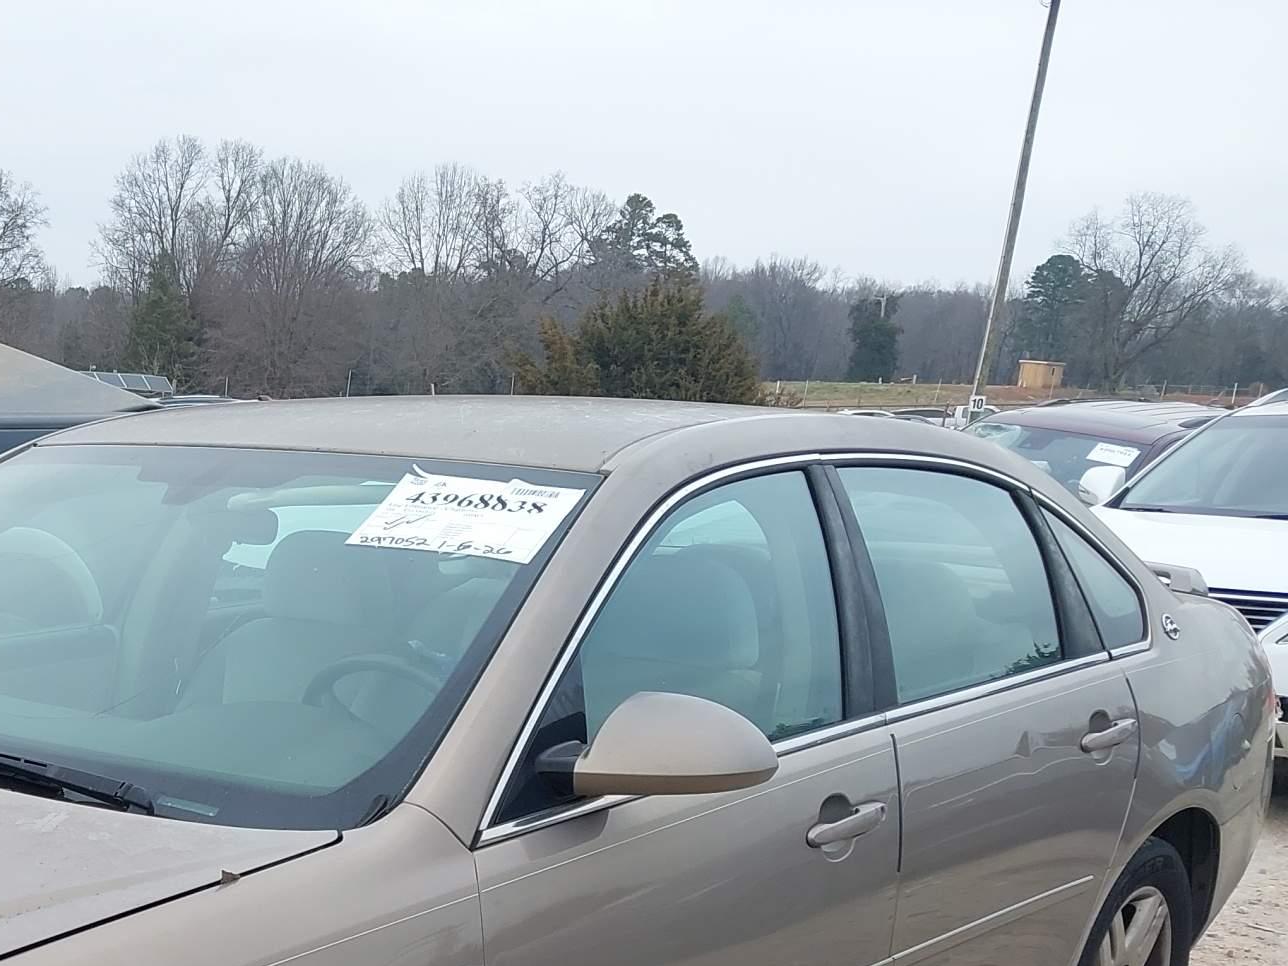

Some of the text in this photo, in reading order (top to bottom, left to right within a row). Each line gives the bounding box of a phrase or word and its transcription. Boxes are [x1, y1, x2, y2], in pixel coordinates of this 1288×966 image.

[971, 398, 984, 410] 10
[405, 490, 548, 514] 43968838
[359, 535, 431, 547] 297052
